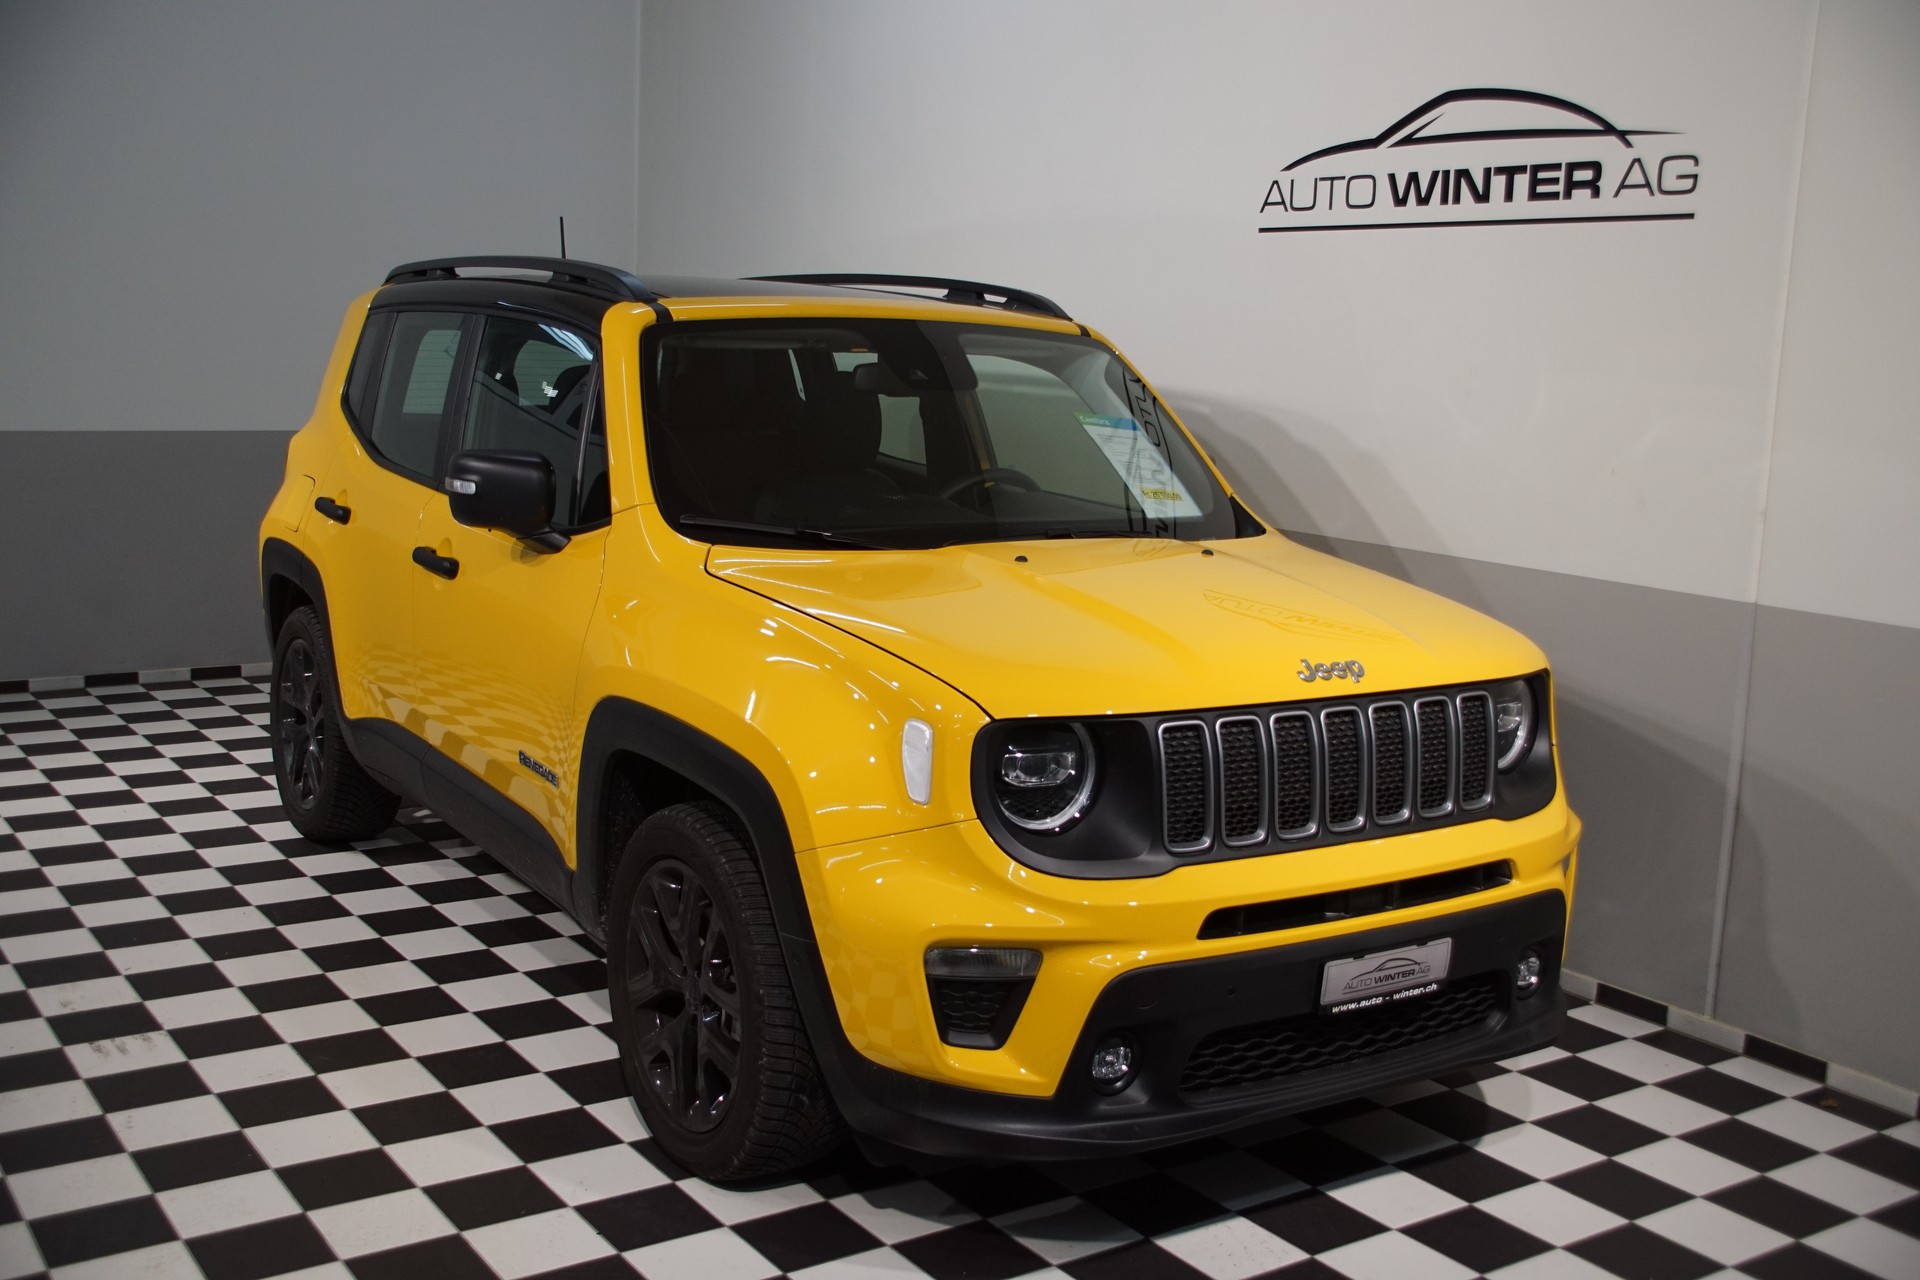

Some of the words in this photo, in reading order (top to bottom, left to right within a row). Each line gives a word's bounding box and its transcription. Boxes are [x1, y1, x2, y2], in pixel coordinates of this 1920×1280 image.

[1259, 174, 1377, 214] AUTO
[1386, 160, 1603, 208] WINTER
[1612, 154, 1700, 199] AG
[1296, 658, 1365, 683] Jeep
[1343, 977, 1373, 991] AUTO
[1374, 968, 1416, 985] WINTER
[1416, 964, 1431, 976] AG
